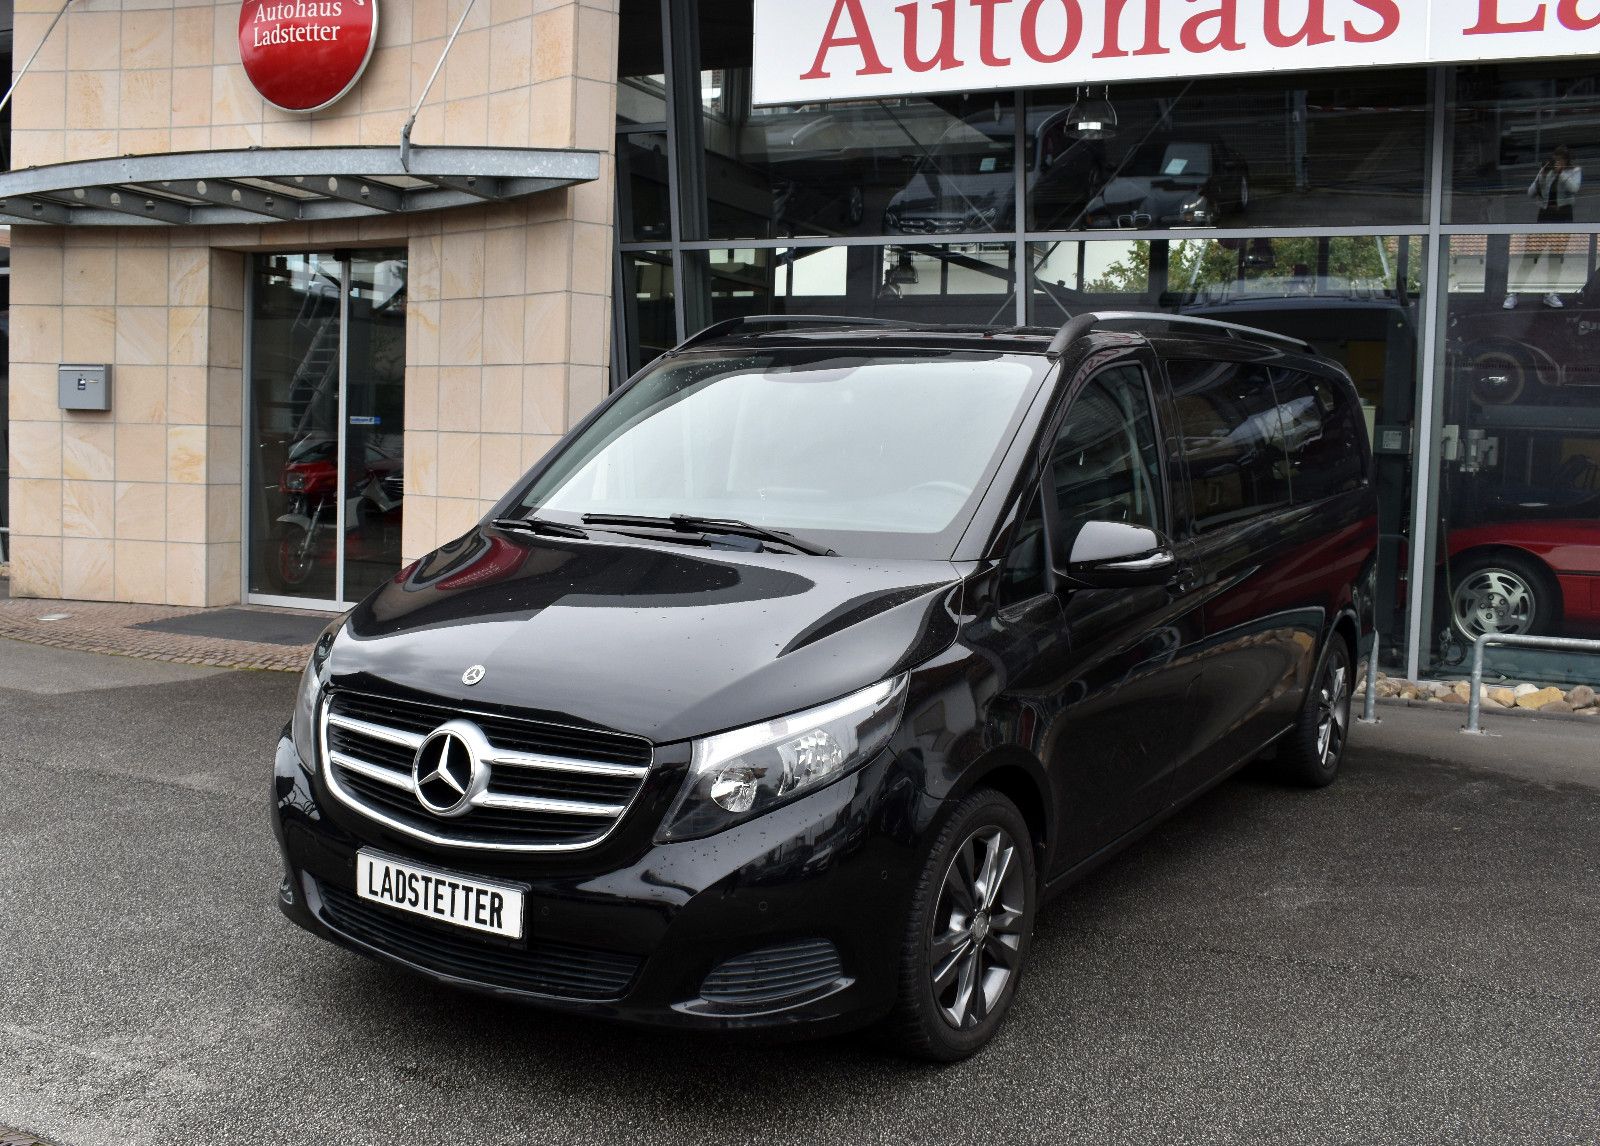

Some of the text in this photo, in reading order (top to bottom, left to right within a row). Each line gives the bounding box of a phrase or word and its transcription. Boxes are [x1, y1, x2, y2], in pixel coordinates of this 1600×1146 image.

[254, 0, 342, 23] Autohaus
[253, 23, 340, 47] Ladstetter
[800, 0, 1400, 80] Autohaus
[368, 861, 504, 929] LADSTETTER
